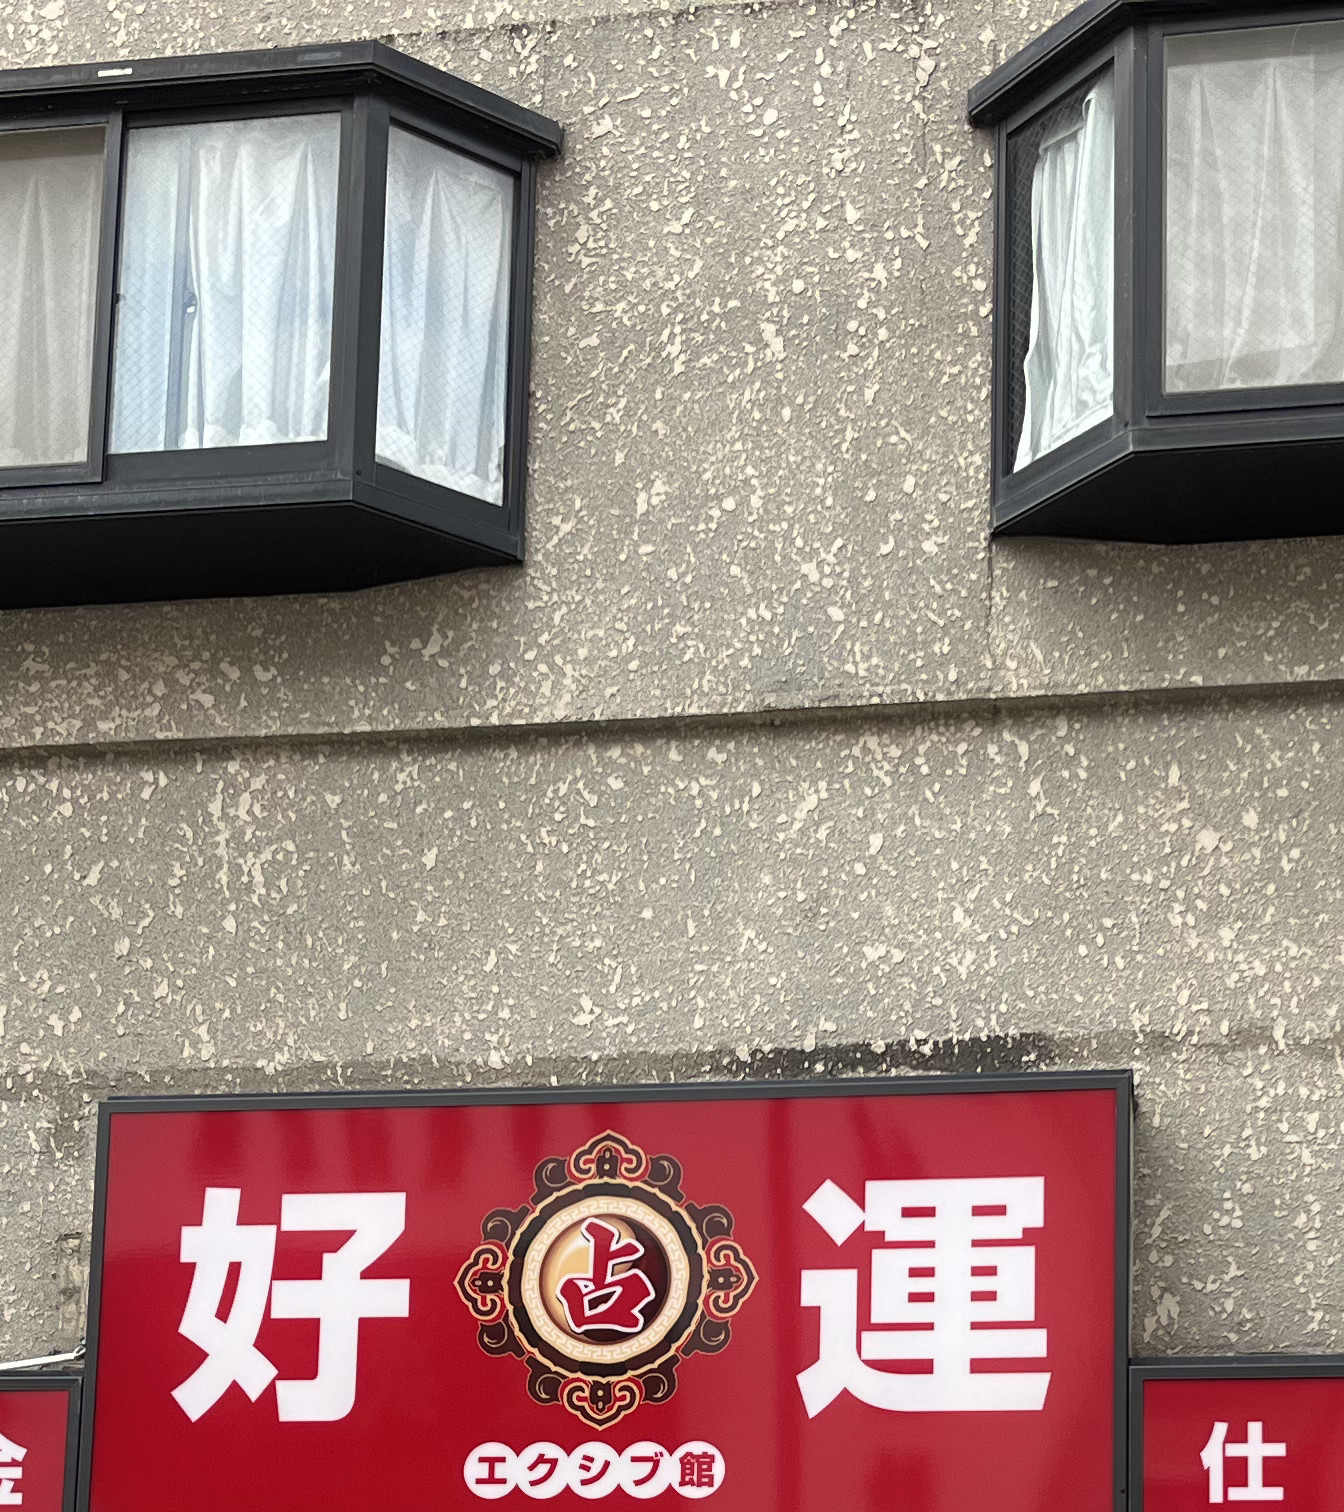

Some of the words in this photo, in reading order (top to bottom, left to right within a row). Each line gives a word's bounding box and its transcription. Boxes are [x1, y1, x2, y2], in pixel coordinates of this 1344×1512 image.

[556, 1215, 656, 1334] 占
[472, 1450, 717, 1490] エクシブ館
